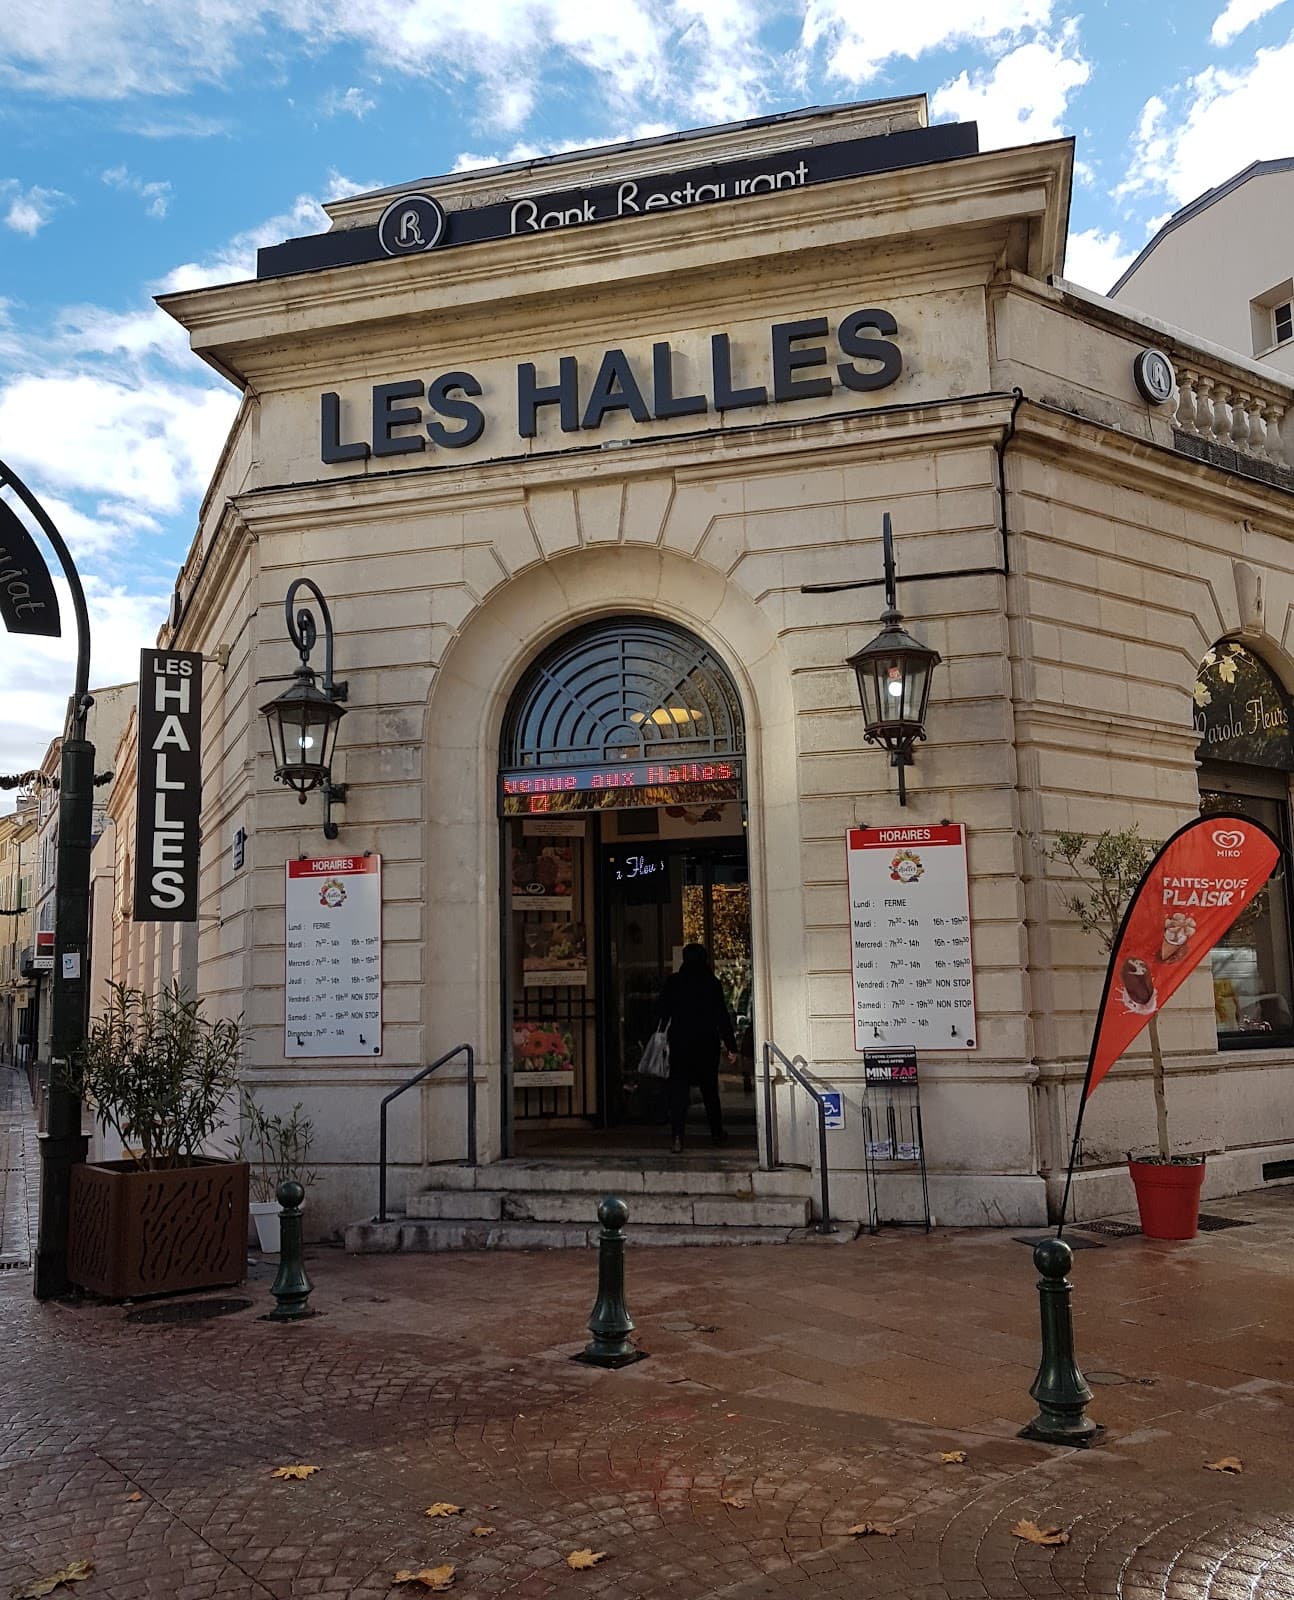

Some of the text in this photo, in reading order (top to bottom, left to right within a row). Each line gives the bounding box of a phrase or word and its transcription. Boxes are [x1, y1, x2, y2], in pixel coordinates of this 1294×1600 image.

[321, 308, 903, 464] LES HALLES
[153, 658, 193, 676] LES
[1246, 695, 1289, 735] Fleurs
[591, 771, 635, 788] aux
[648, 764, 732, 783] Halles
[150, 676, 191, 909] HALLES
[879, 829, 931, 842] HORAIRES
[312, 859, 354, 871] HORAIRES
[1163, 877, 1249, 890] FAITES-VOUS
[853, 900, 870, 909] Lundi
[884, 899, 907, 908] FERME
[1162, 889, 1234, 907] PLAISIR
[854, 920, 872, 928] Mardi
[908, 919, 919, 927] 14h
[933, 918, 944, 926] 16h
[855, 940, 882, 948] Mercredi
[909, 939, 920, 947] 14h
[856, 961, 873, 969] Jeudi
[935, 960, 946, 968] 16h
[857, 980, 884, 989] Vendredi
[936, 979, 950, 987] NON
[953, 979, 971, 987] STOP
[858, 1001, 881, 1009] Samedi
[937, 1000, 951, 1008] NON
[954, 1000, 972, 1008] STOP
[858, 1020, 889, 1028] Dimanche
[918, 1019, 929, 1027] 14h
[866, 1066, 917, 1078] MINIZAP
